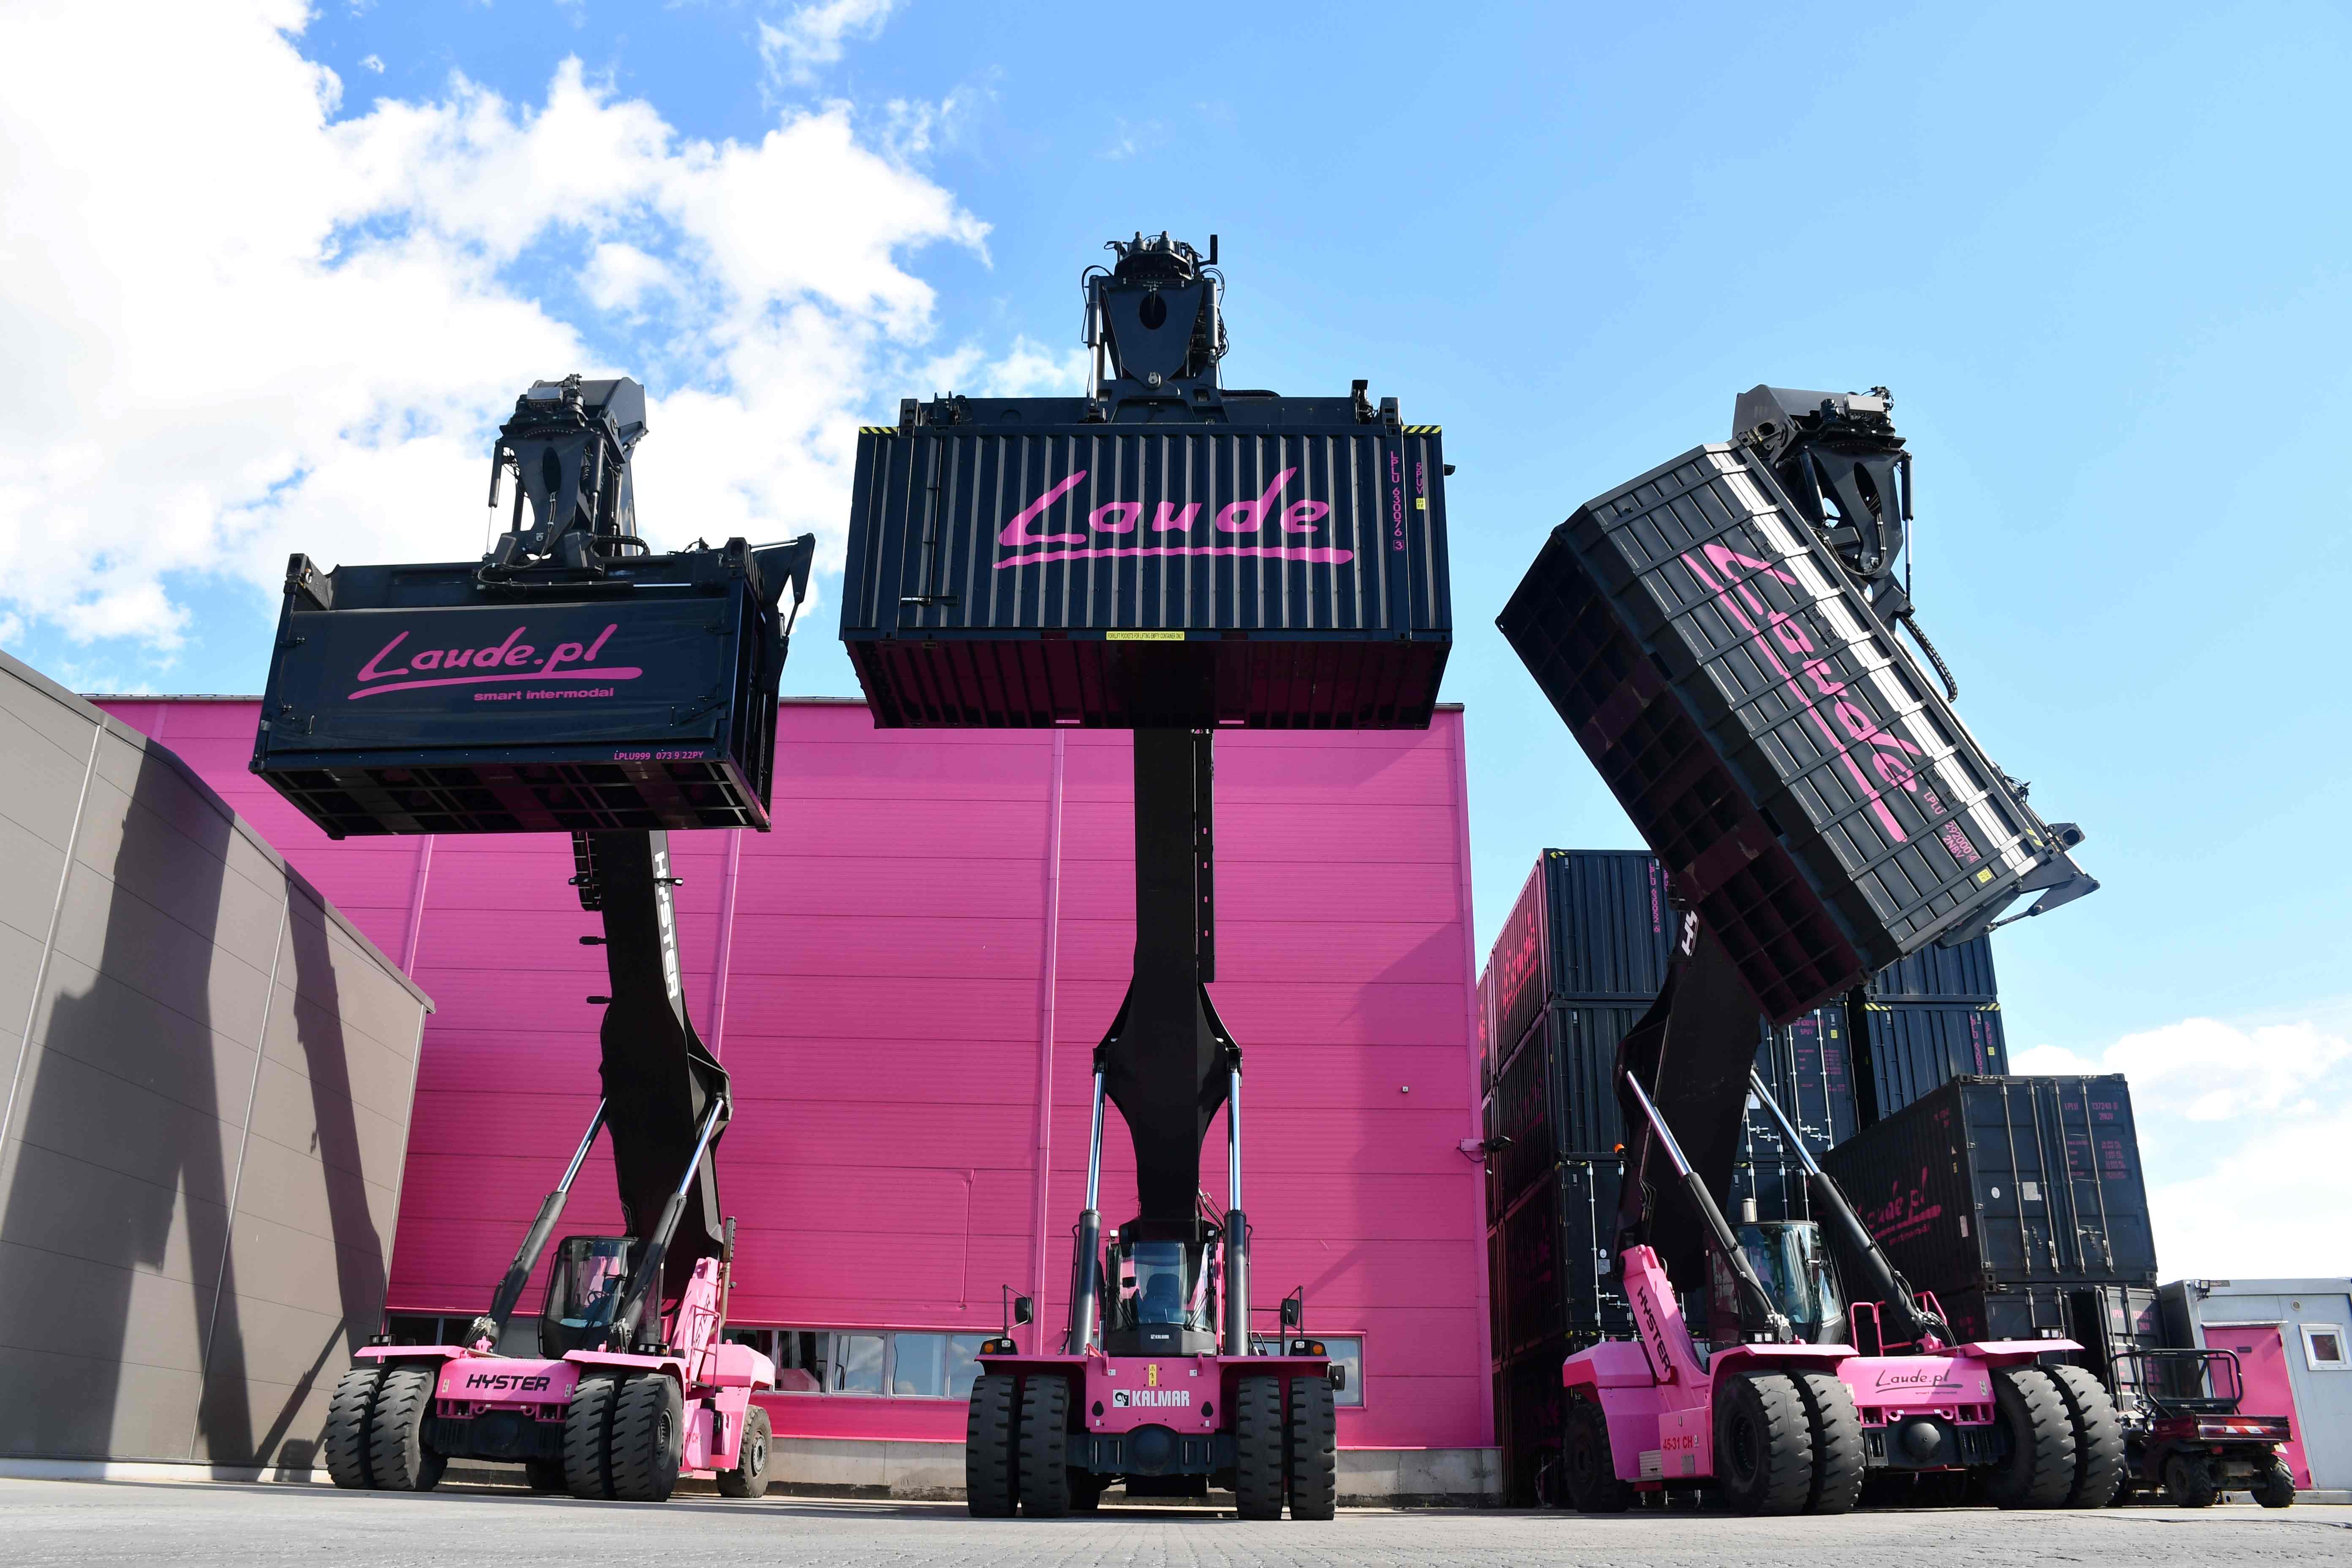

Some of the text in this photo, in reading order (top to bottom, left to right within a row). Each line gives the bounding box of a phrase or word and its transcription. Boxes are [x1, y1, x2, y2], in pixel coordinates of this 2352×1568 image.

[1391, 451, 1400, 482] LPLU
[998, 467, 1330, 546] Laude
[1392, 487, 1402, 536] 630076
[357, 623, 618, 682] Laude.pl
[1702, 544, 1922, 792] Laude
[474, 687, 614, 701] smart intermodal
[1923, 792, 1944, 815] LPLU
[1944, 821, 1972, 855] 292000
[1942, 835, 1965, 858] 2NBV
[1970, 1015, 1984, 1075] LPLU 63007
[1637, 1286, 1671, 1373] HYSTER
[466, 1374, 550, 1391] HYSTER
[1875, 1369, 1950, 1387] Laude.pl
[1132, 1390, 1190, 1407] KALMAR
[1662, 1435, 1692, 1451] 45-31 CH
